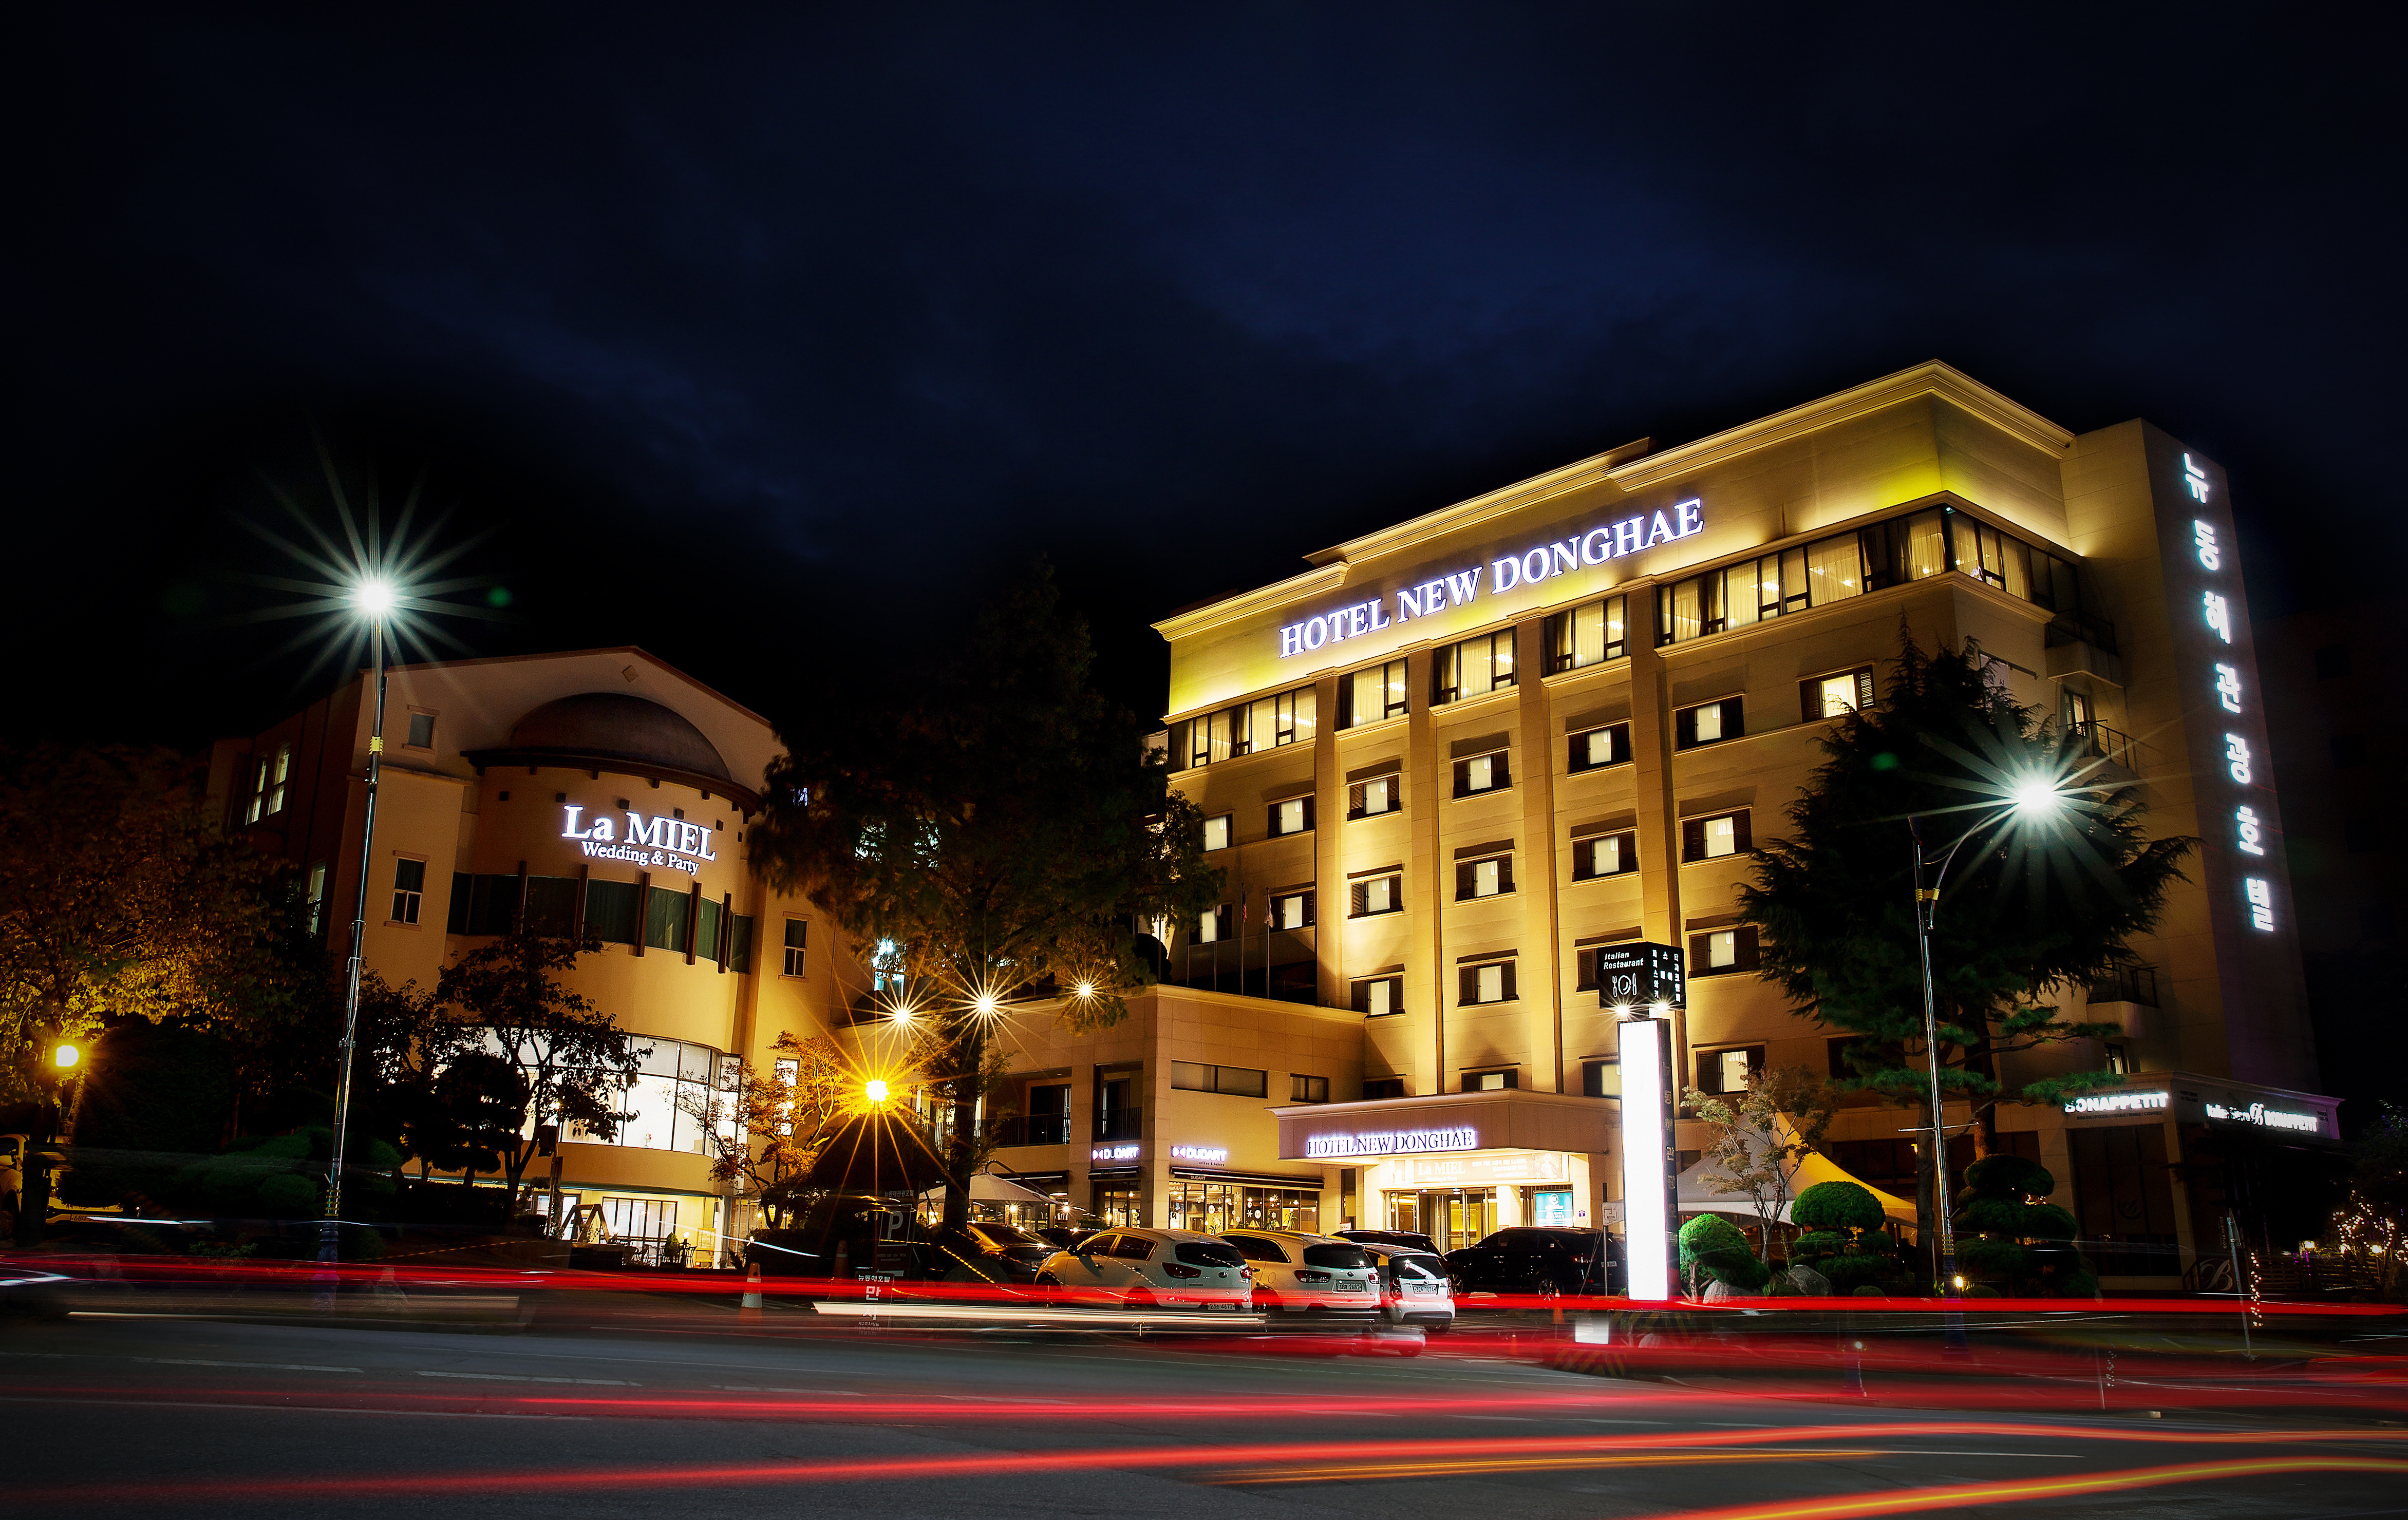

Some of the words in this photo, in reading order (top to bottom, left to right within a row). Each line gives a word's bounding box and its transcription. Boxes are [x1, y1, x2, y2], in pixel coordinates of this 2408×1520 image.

[1280, 598, 1390, 658] HOTEL
[1397, 566, 1482, 622] NEW
[1491, 498, 1703, 595] DONGHAE
[2184, 452, 2273, 932] 뉴동해관광호텔
[561, 805, 614, 841] La
[624, 812, 716, 861] MIEL
[581, 841, 648, 866] Wedding
[651, 850, 664, 866] &
[667, 853, 699, 876] Party
[1603, 958, 1644, 970] Restaurant
[1605, 952, 1629, 960] Italian
[2064, 1092, 2168, 1113] BONAPPETIT
[1186, 1147, 1228, 1162] DUDART
[1307, 1138, 1354, 1157] HOTEL
[1356, 1134, 1391, 1154] NEW
[1394, 1130, 1473, 1152] DONGHAE
[1418, 1163, 1432, 1175] La
[1434, 1161, 1466, 1175] MIEL
[887, 1210, 904, 1240] P
